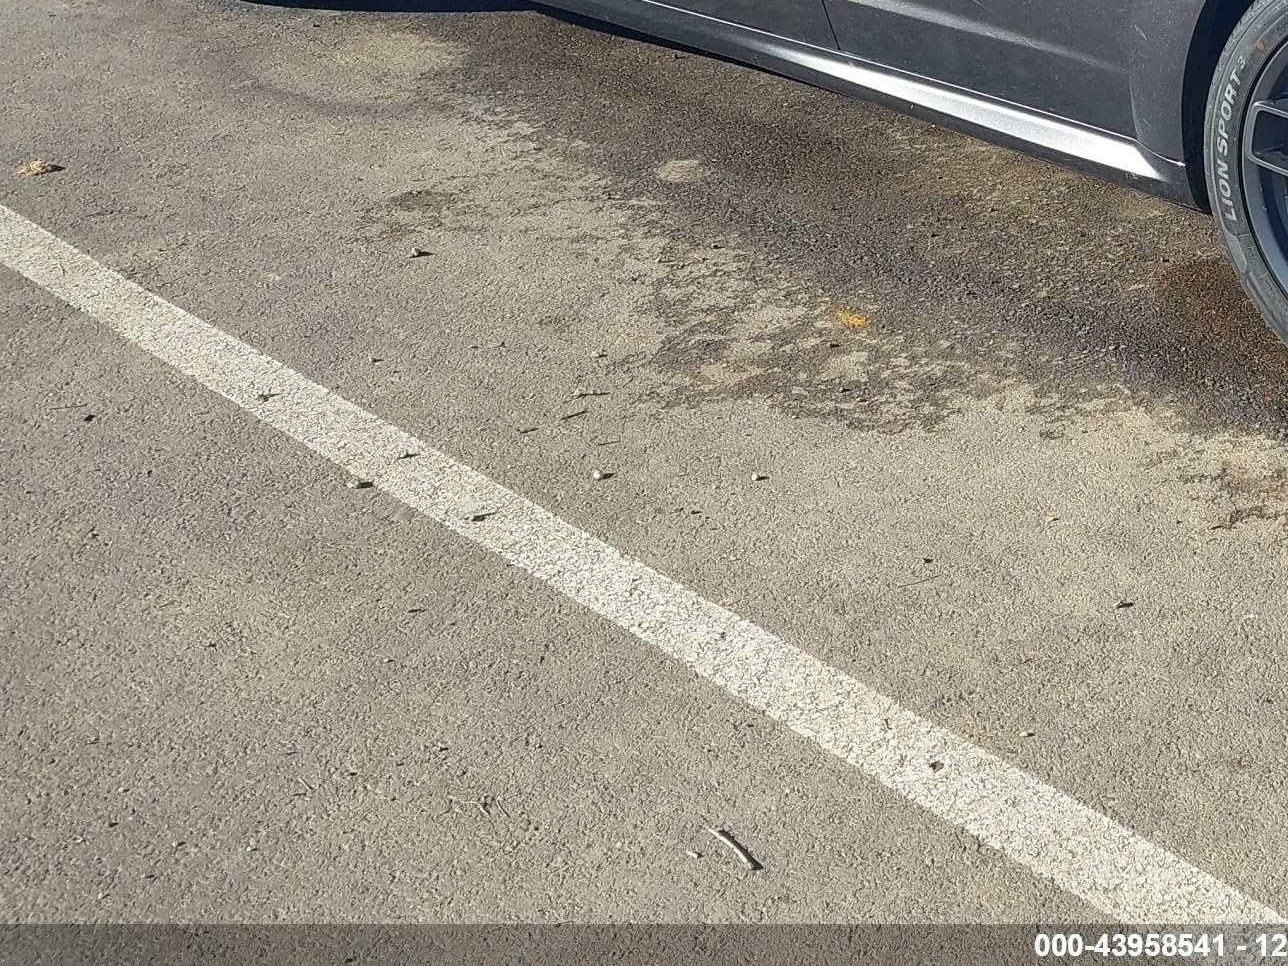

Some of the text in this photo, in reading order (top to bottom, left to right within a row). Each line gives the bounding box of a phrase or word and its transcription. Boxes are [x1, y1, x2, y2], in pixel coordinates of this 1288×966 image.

[1216, 55, 1246, 222] LION SPORT 3
